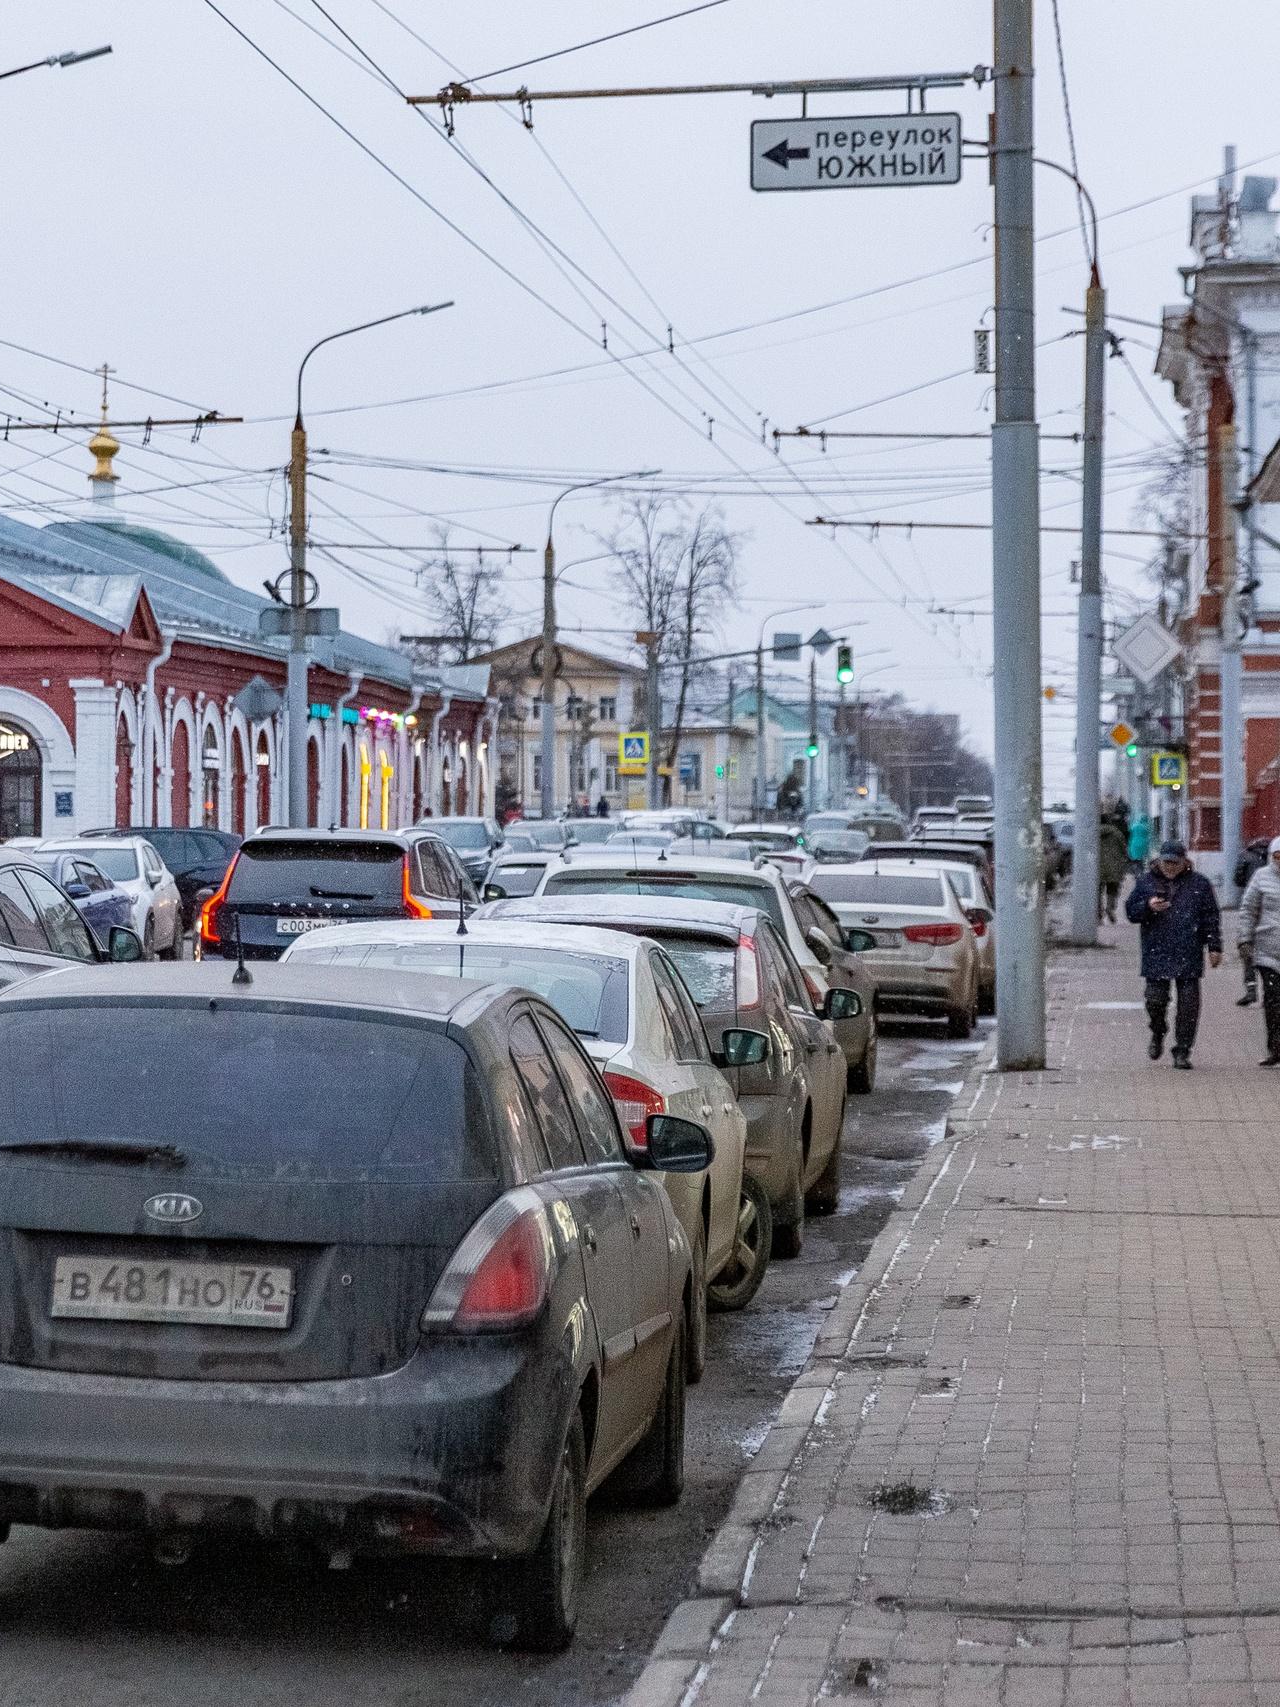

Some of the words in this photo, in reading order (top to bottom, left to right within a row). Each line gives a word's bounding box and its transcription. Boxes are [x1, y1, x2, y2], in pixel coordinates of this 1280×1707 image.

[816, 127, 952, 152] переулок
[817, 147, 946, 180] ЮЖНЫЙ
[153, 1197, 194, 1217] KIA
[237, 1269, 277, 1301] 76
[234, 1298, 264, 1312] RUS
